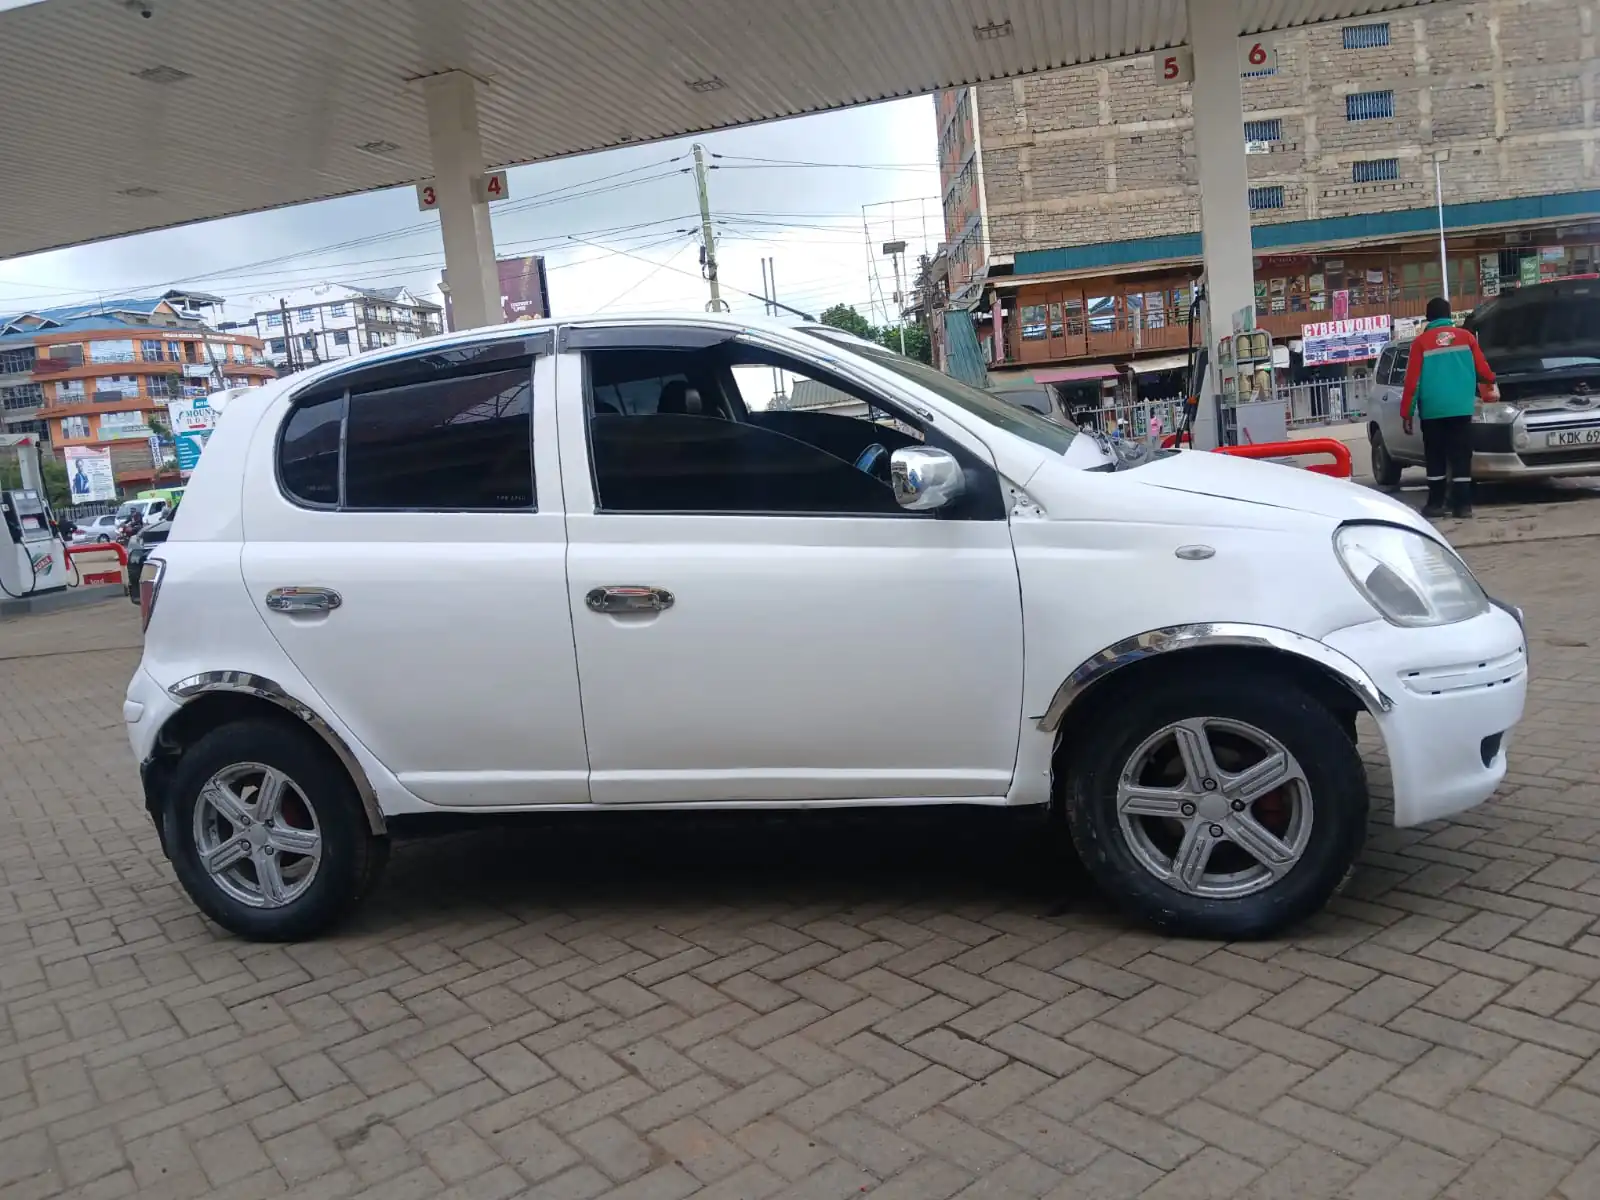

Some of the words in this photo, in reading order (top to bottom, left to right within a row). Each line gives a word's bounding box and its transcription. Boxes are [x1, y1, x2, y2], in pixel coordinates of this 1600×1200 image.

[1248, 43, 1267, 65] 6
[1164, 57, 1179, 79] 5
[423, 186, 436, 205] 3
[487, 176, 501, 195] 4
[1303, 315, 1389, 337] CYBERWORLD
[1559, 432, 1580, 444] KDK
